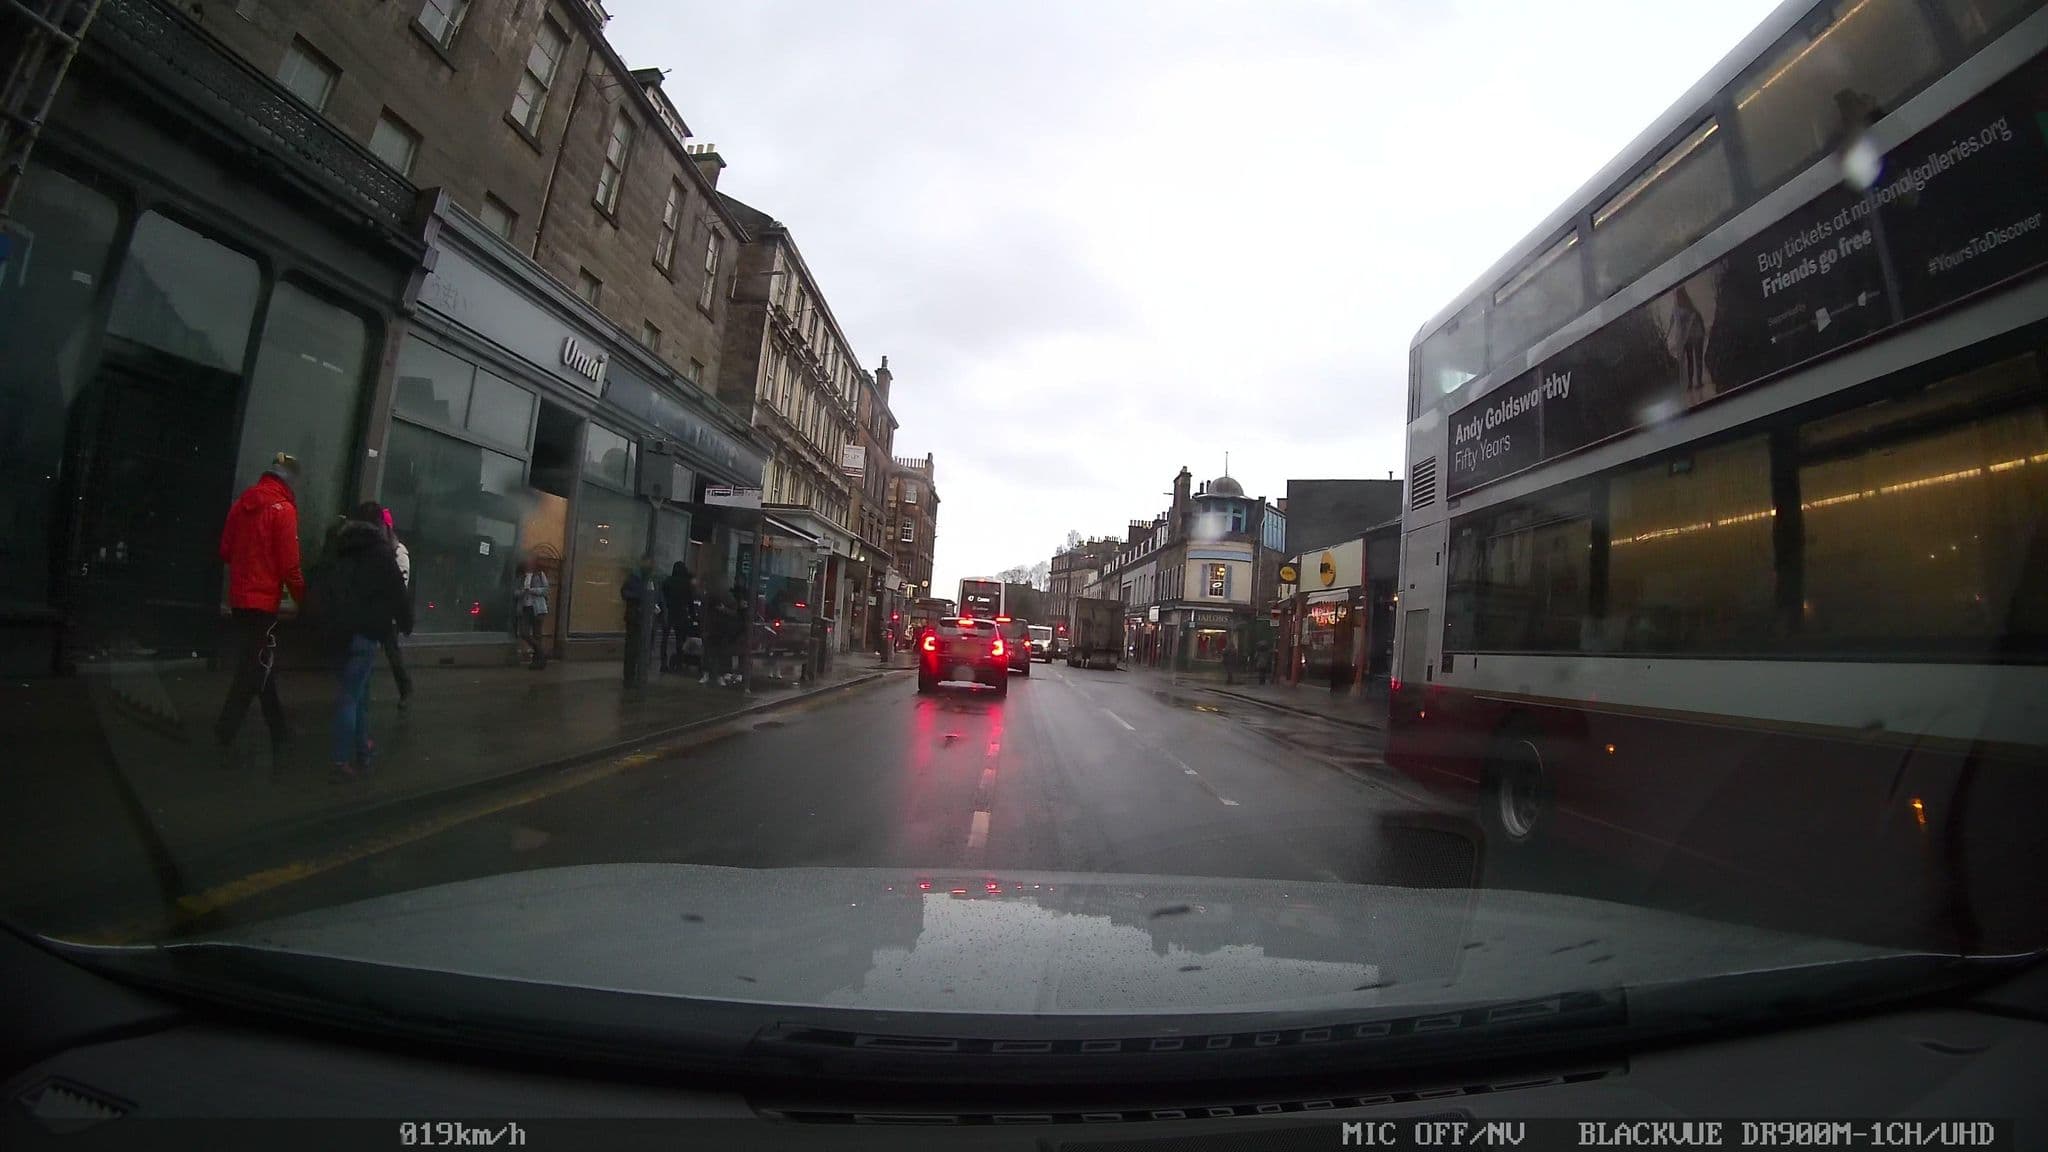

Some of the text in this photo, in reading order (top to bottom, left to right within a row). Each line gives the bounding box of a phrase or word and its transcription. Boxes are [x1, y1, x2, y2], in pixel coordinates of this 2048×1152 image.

[1757, 246, 1784, 273] Buy
[1785, 219, 1833, 258] tickets
[1833, 206, 1850, 229] at
[1761, 228, 1873, 298] Friends go free
[1926, 211, 2042, 275] #YoursToDiscover
[1455, 370, 1572, 445] Andy Goldsworthy
[1454, 434, 1511, 473] Fifty Years
